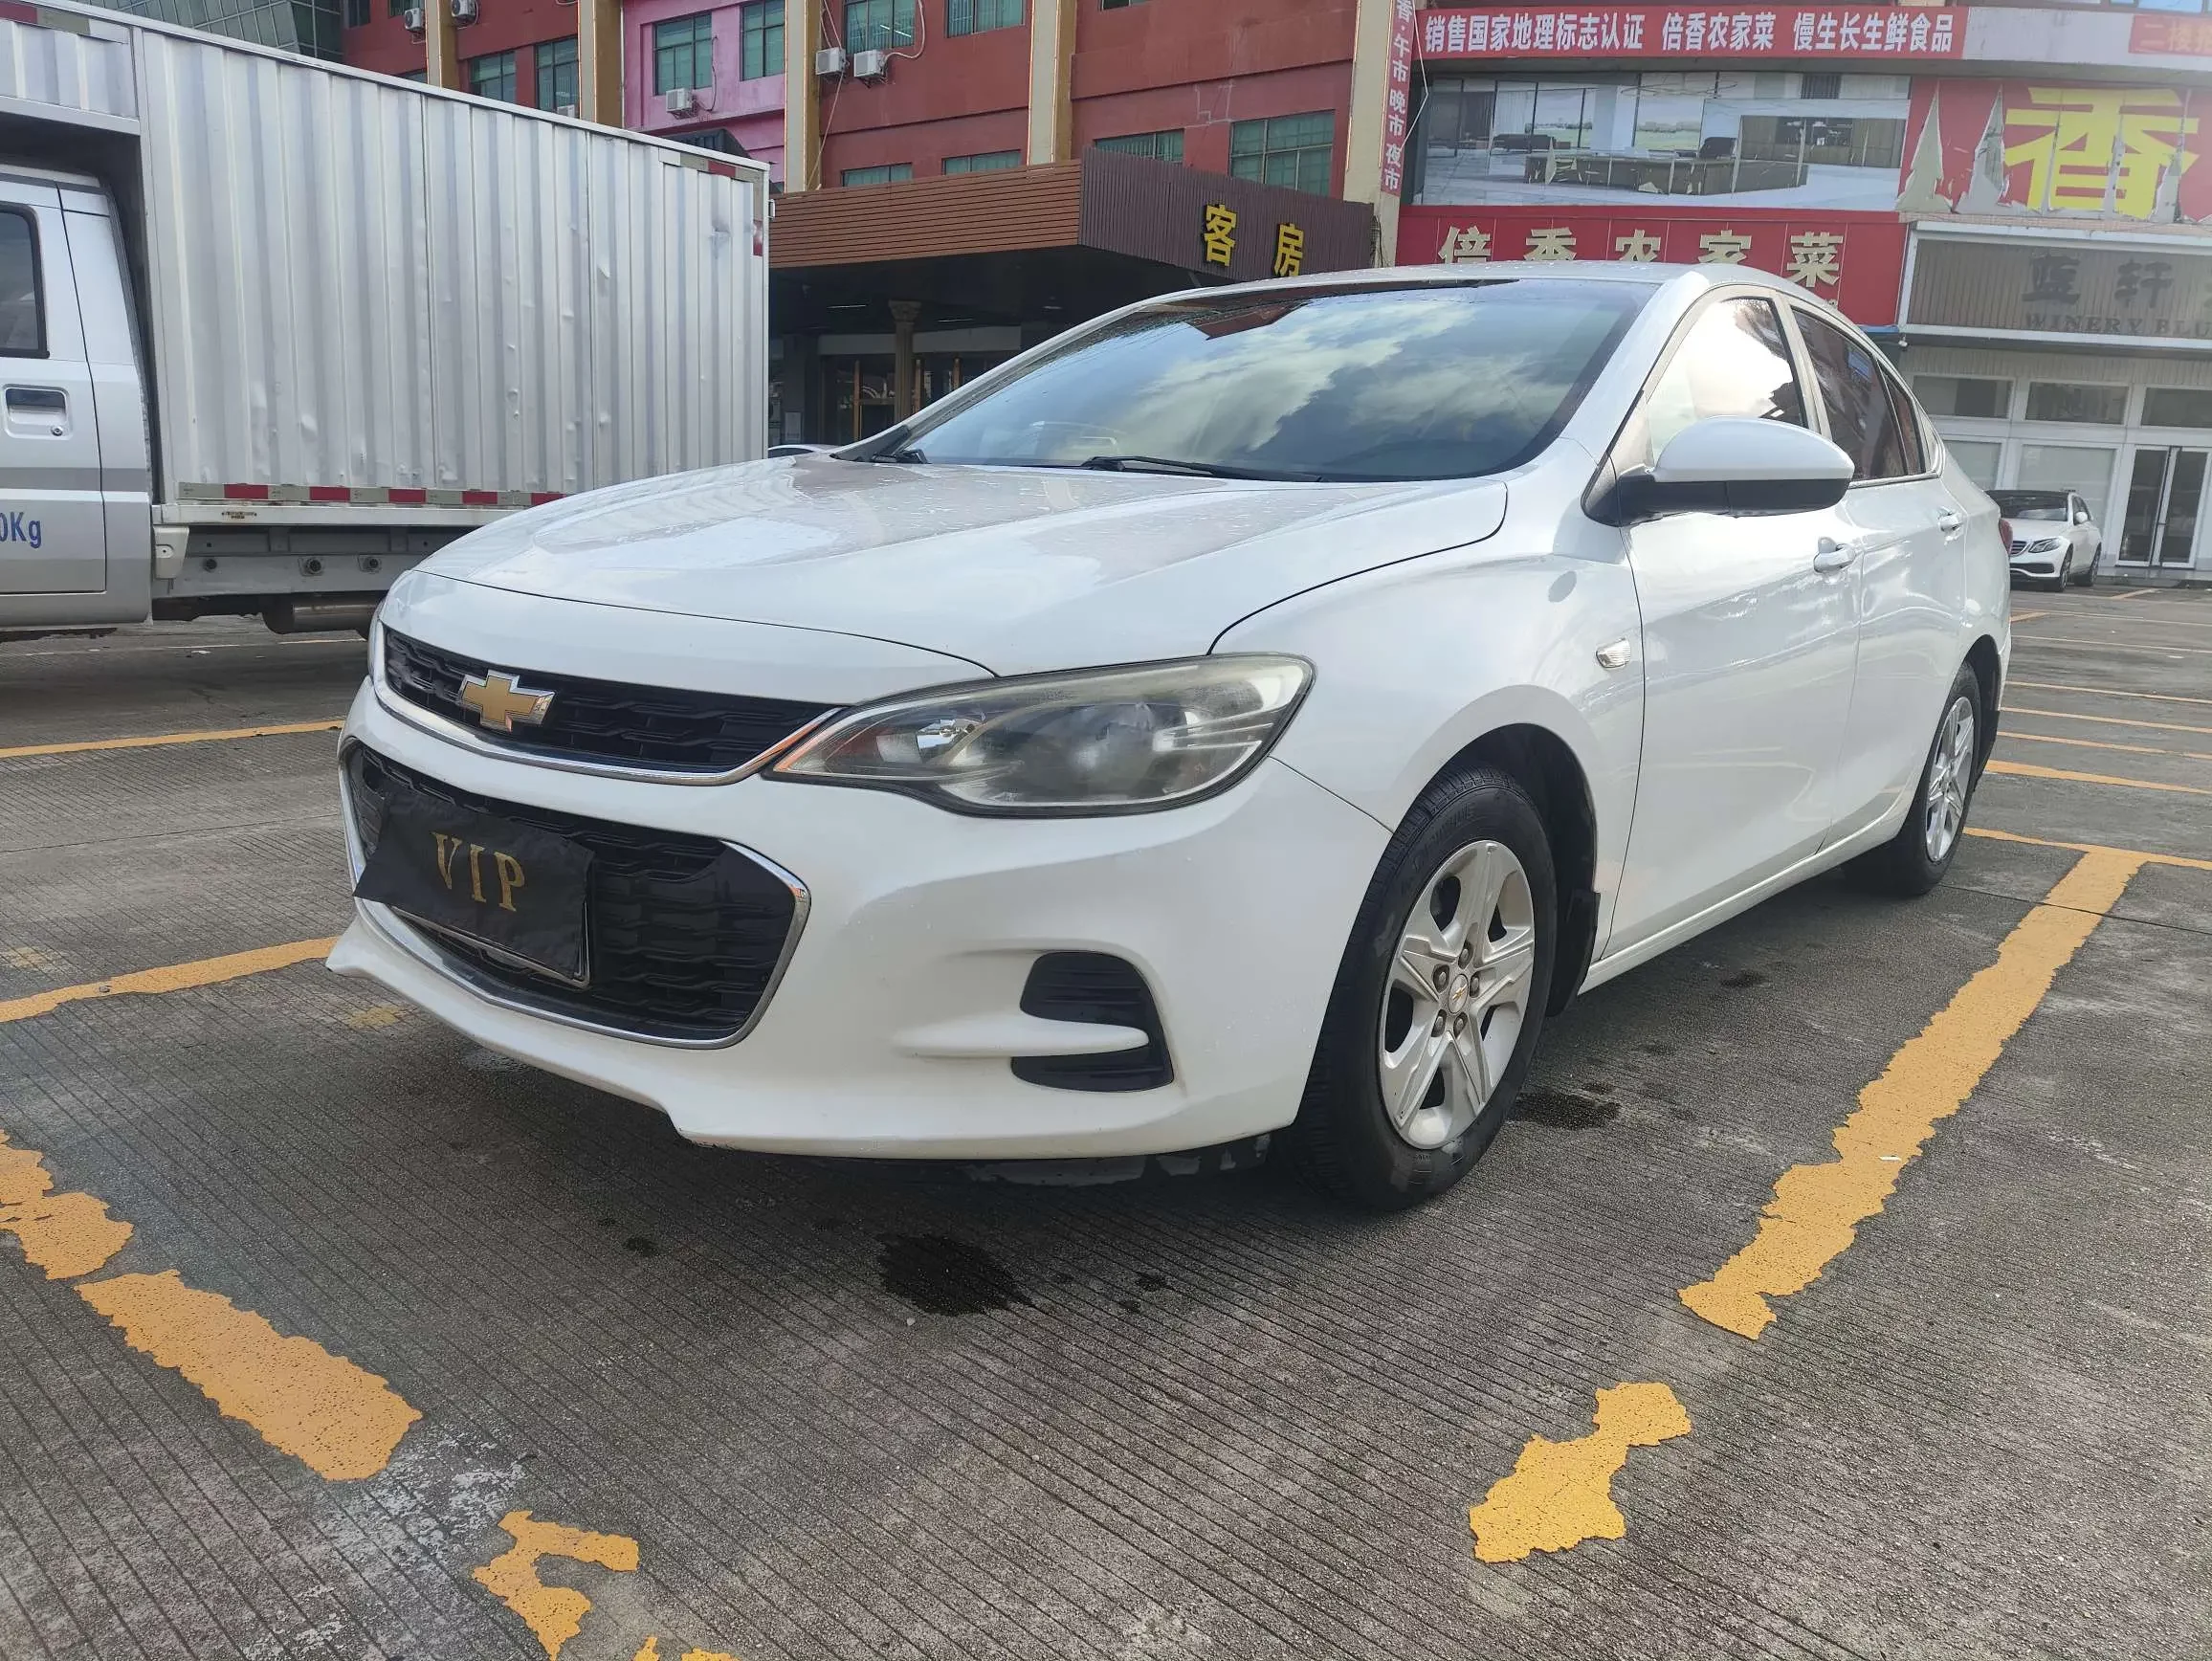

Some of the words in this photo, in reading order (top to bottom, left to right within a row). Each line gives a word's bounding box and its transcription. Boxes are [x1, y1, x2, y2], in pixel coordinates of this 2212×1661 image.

[1425, 12, 1646, 53] 销售国家地理标志认证
[1662, 11, 1777, 51] 倍香农家菜
[1793, 11, 1954, 53] 慢生长生鲜食品
[1388, 88, 1406, 137] 晚市
[1384, 143, 1403, 190] 夜市
[2003, 87, 2201, 220] 香
[1204, 204, 1304, 277] 客房
[1438, 225, 1845, 287] 倍香农家菜
[2025, 312, 2144, 335] WINERY
[430, 830, 525, 912] VIP
